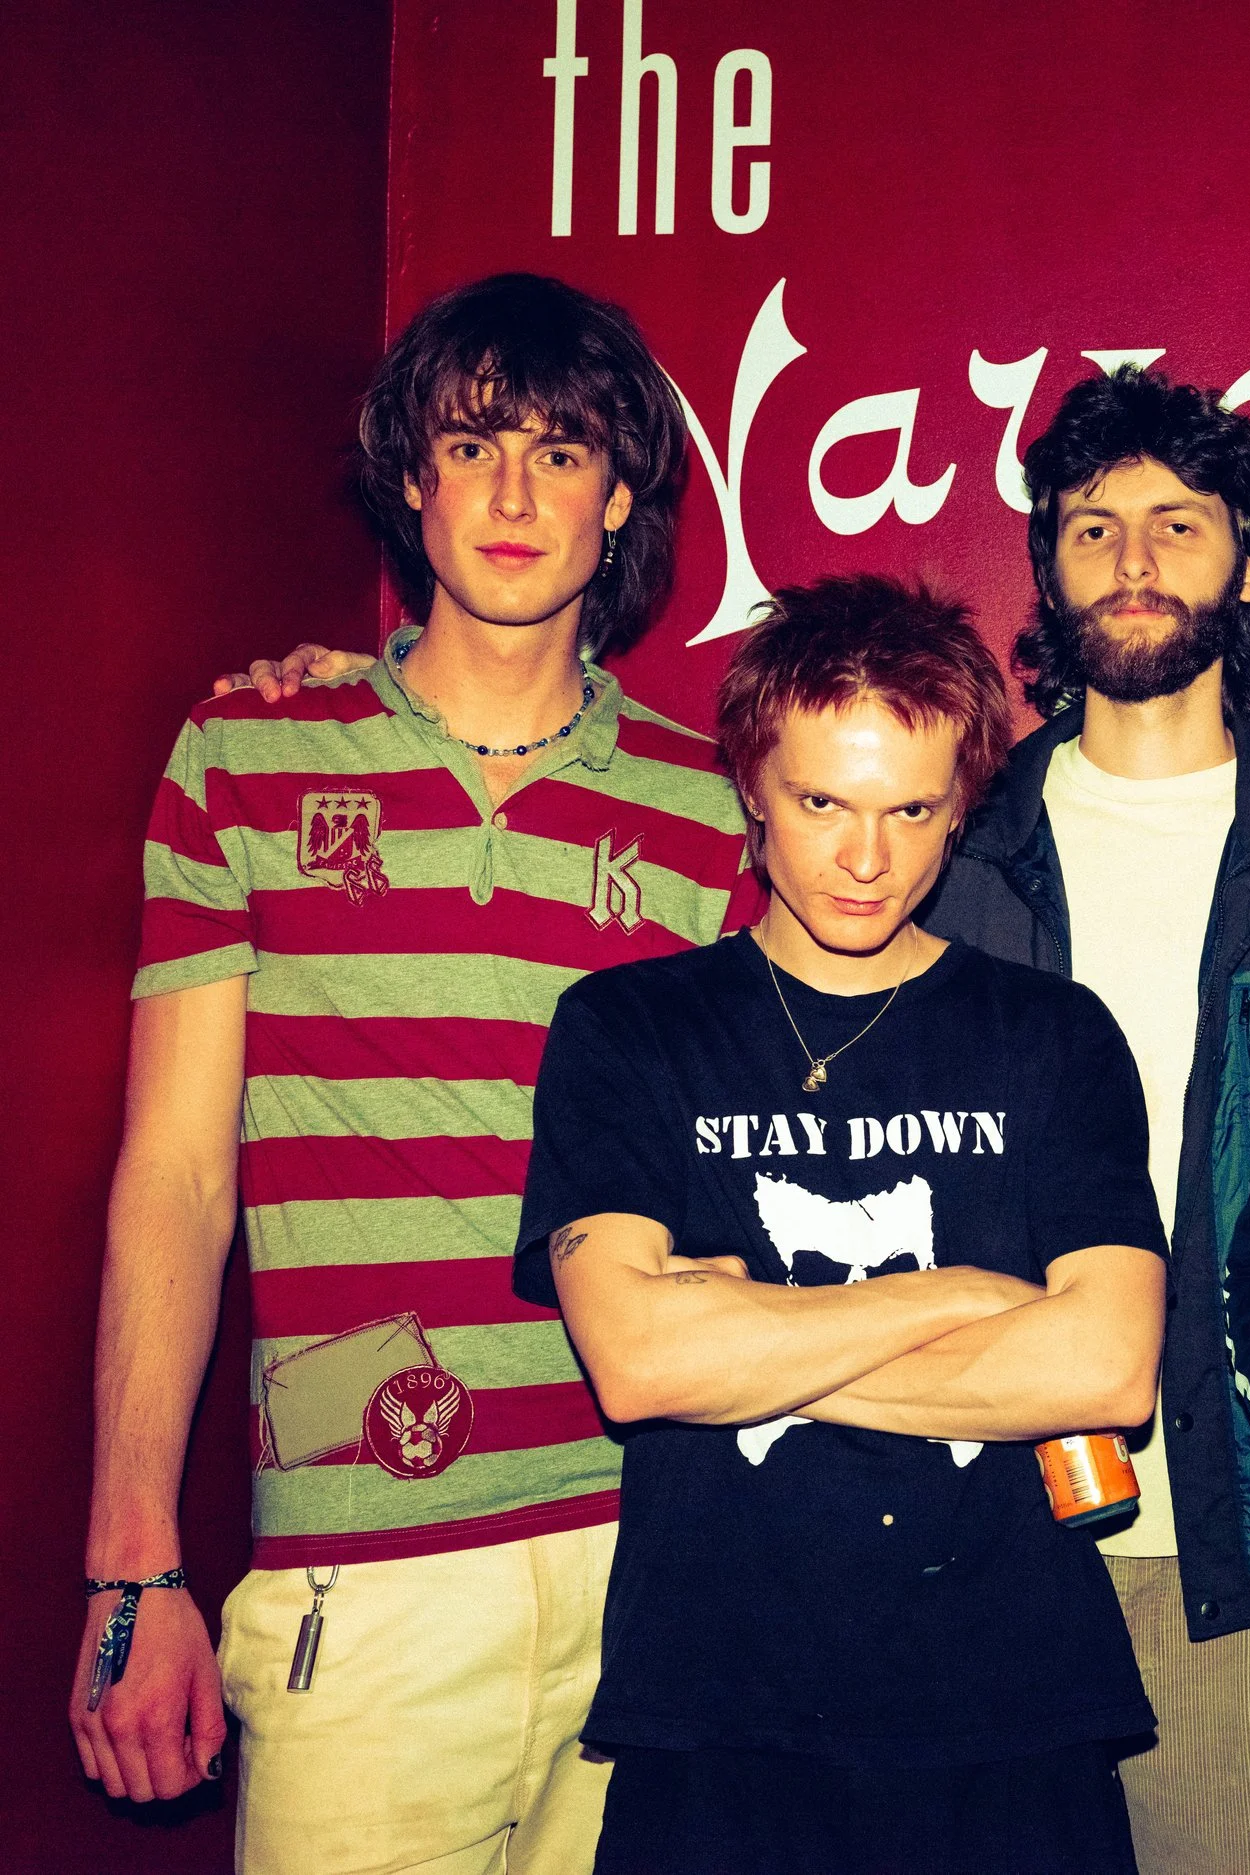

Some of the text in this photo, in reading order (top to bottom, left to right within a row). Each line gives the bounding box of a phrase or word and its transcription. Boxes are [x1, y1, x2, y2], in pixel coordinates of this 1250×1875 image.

[543, 0, 773, 237] the
[695, 1110, 1007, 1160] STAY DOWN
[393, 1371, 446, 1395] 1896
